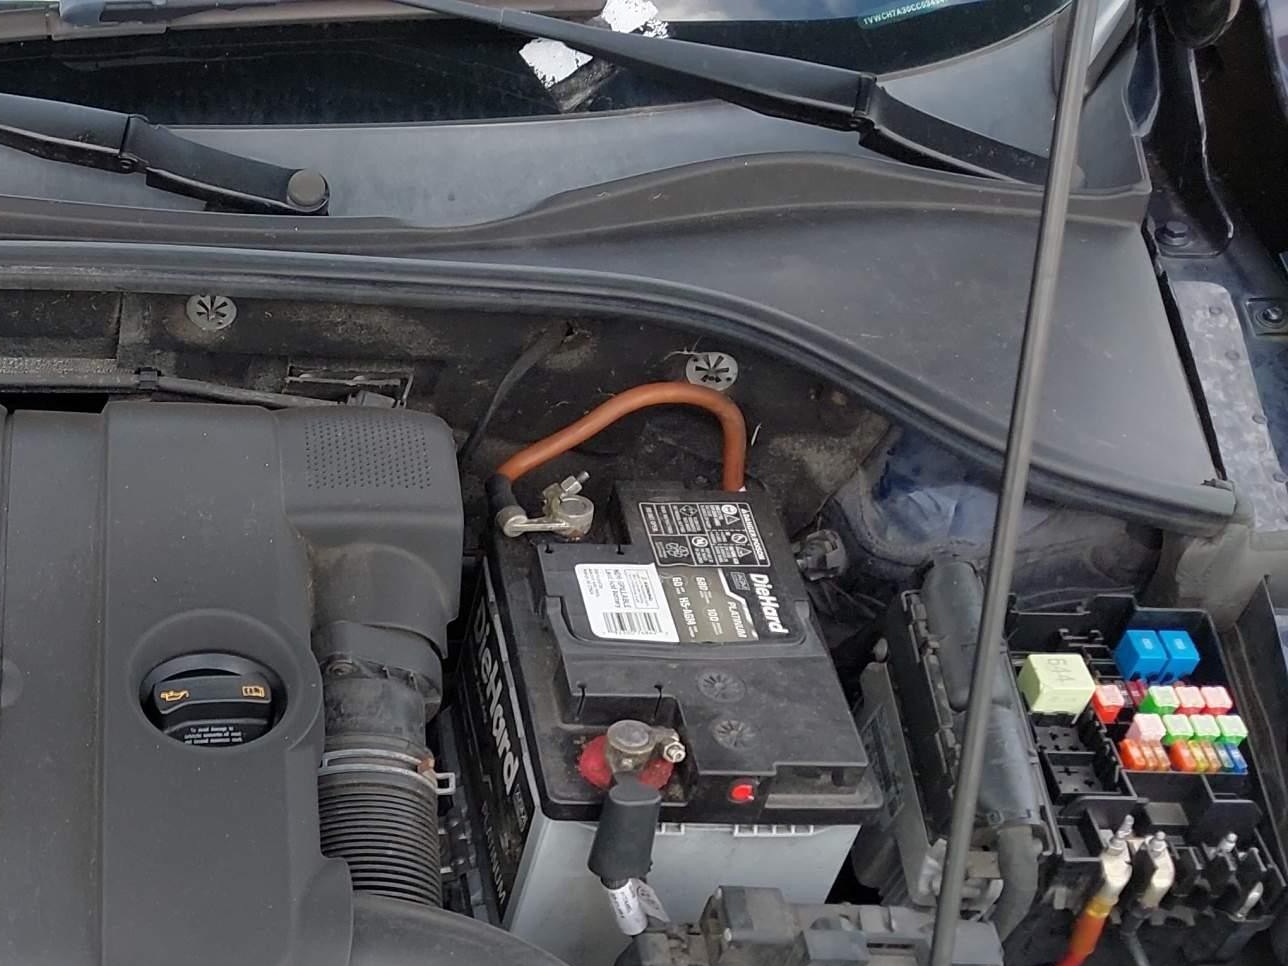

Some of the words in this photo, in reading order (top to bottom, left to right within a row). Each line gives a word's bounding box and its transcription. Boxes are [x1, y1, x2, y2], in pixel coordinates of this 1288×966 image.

[727, 601, 747, 638] PLATINUM
[749, 573, 790, 635] DieHard
[474, 596, 519, 796] DieHard
